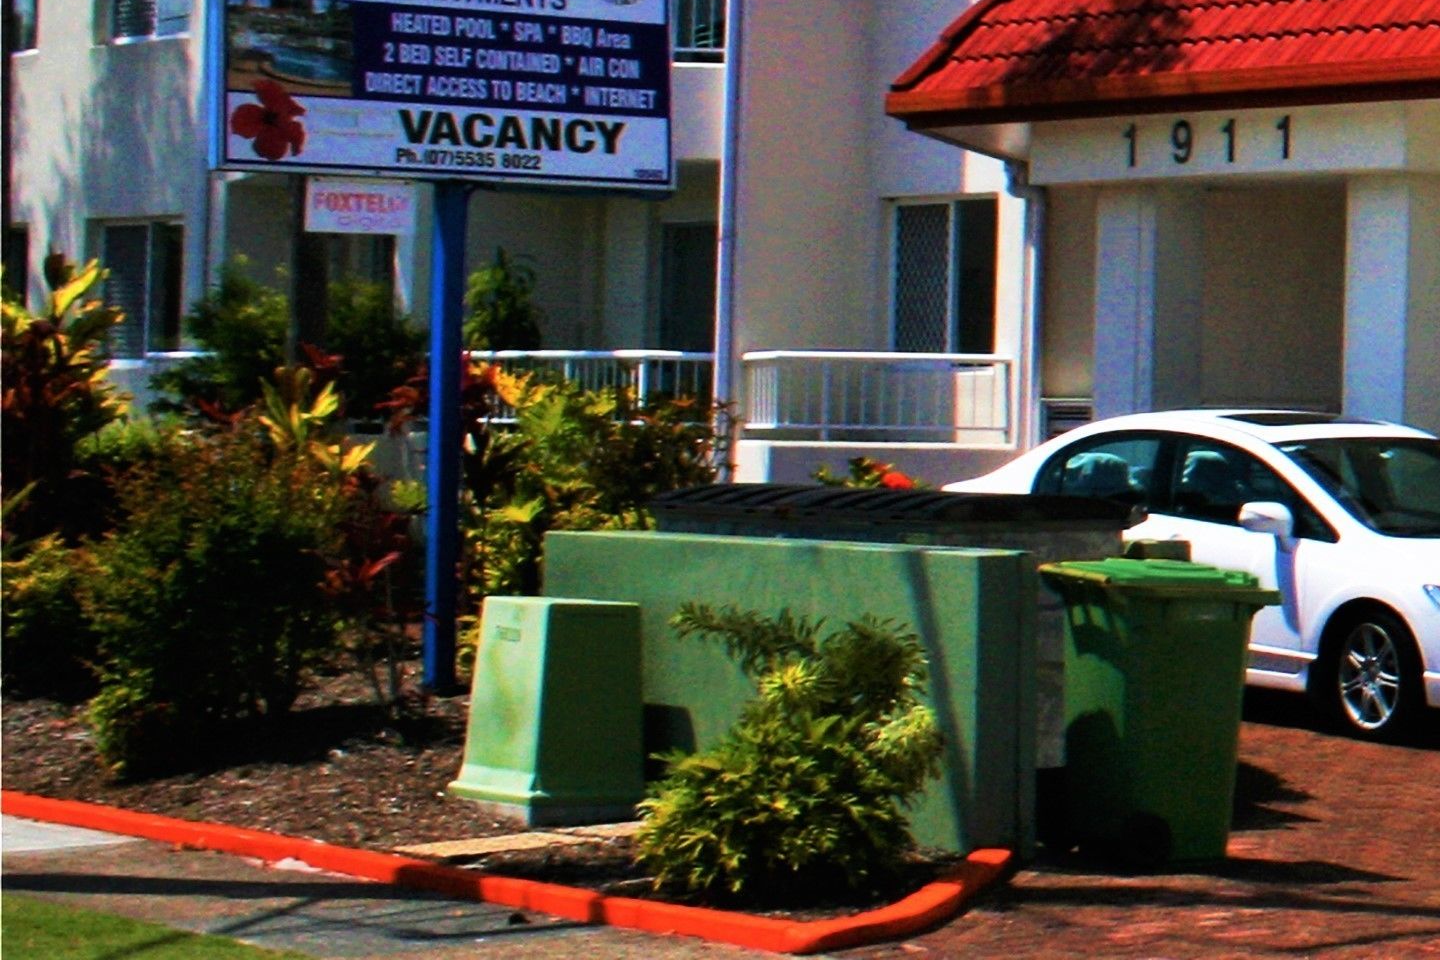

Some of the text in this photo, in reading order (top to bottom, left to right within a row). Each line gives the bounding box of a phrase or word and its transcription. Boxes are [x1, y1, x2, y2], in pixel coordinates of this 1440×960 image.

[391, 12, 632, 49] HEATED POOL SPA BBQ Area
[383, 42, 640, 80] 2 BED SELF CONTAINED AIR CON
[365, 71, 657, 109] DIRECT ACCESS TO BEACH INTERNET
[399, 109, 626, 154] VACANCY
[1123, 114, 1291, 167] 1911
